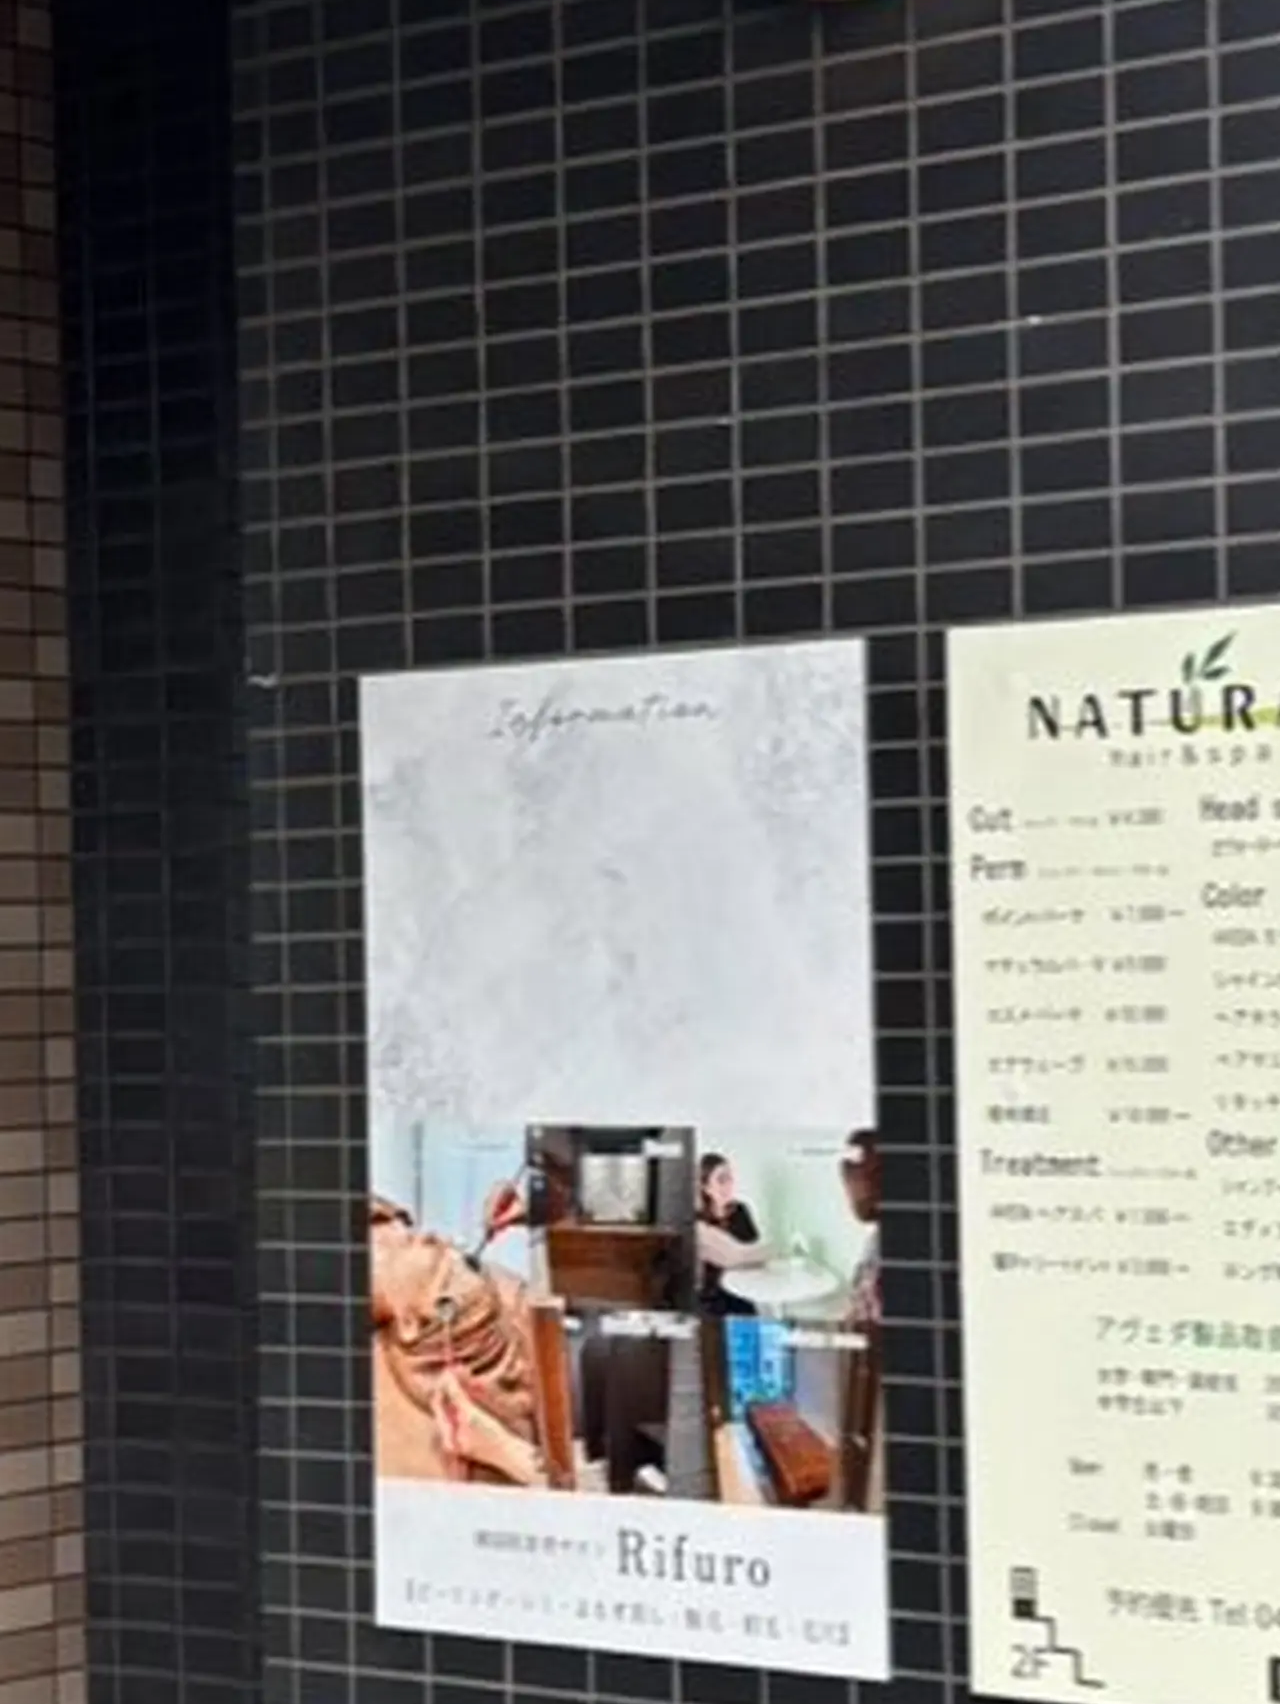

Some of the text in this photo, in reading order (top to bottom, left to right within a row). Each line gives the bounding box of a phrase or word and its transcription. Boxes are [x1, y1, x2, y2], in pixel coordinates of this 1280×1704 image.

[1201, 880, 1267, 909] Color
[1204, 1127, 1279, 1159] Other
[617, 1527, 772, 1588] Rifuro
